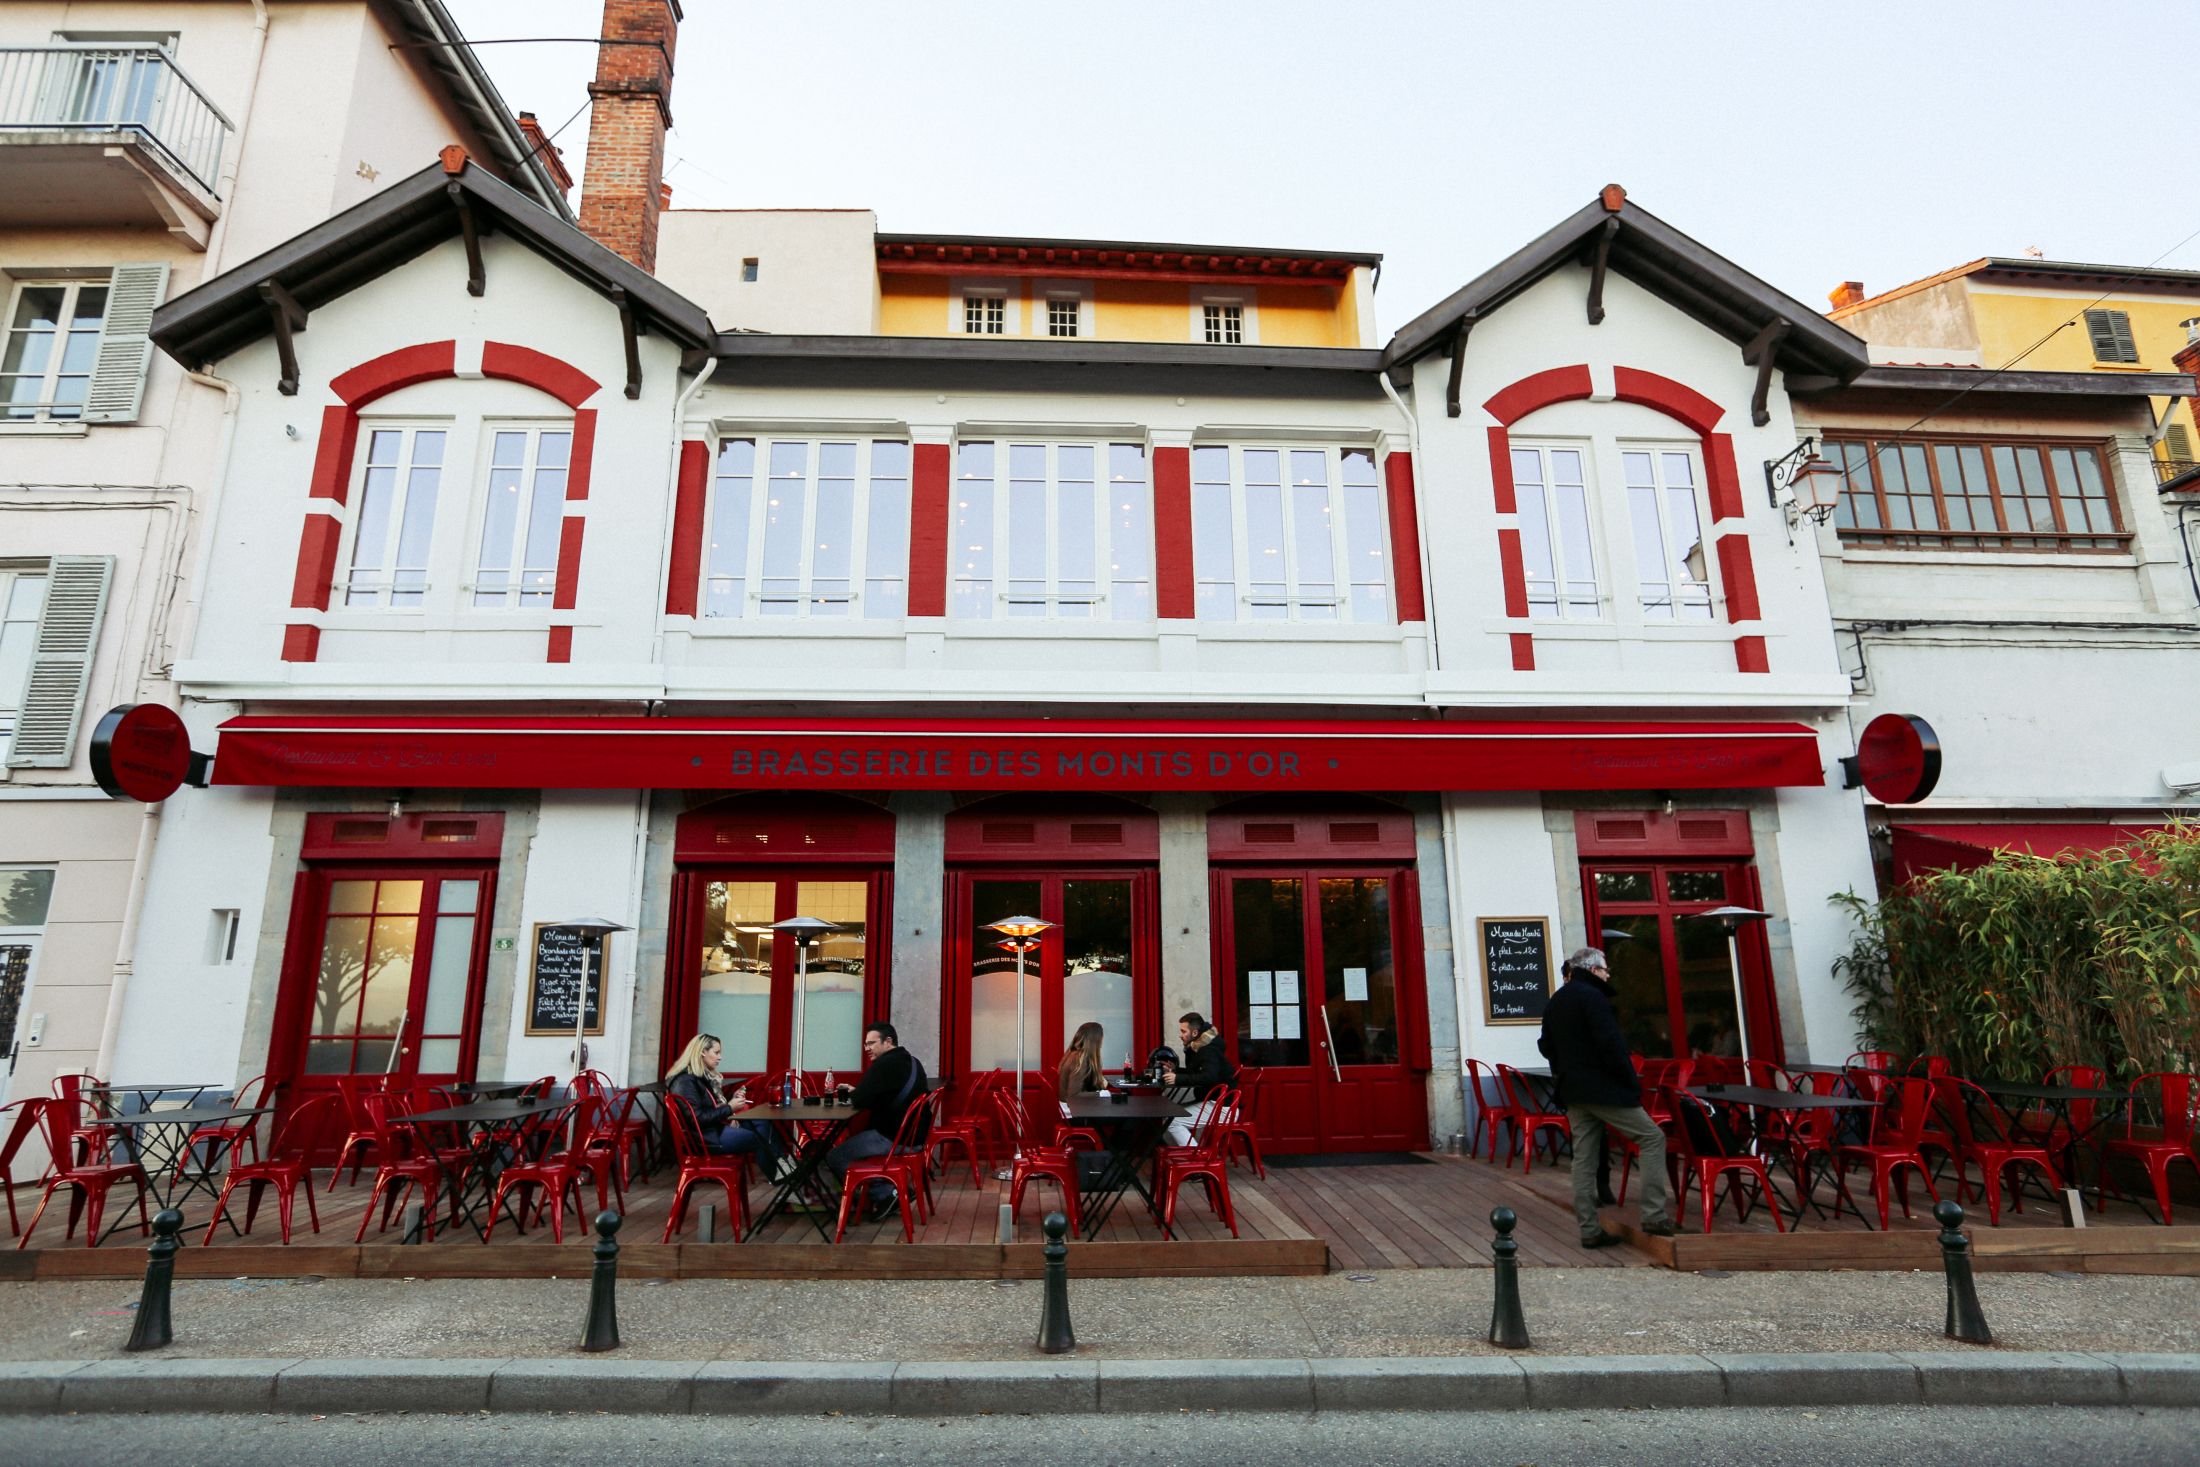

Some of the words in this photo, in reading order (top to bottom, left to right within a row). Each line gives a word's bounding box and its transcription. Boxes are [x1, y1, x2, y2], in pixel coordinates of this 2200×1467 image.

[731, 749, 951, 776] BRASSERIE
[967, 750, 1041, 777] DES
[1057, 750, 1194, 777] MONTS
[1208, 750, 1301, 777] D'OR
[1491, 961, 1497, 971] 2
[1492, 980, 1499, 992] 3
